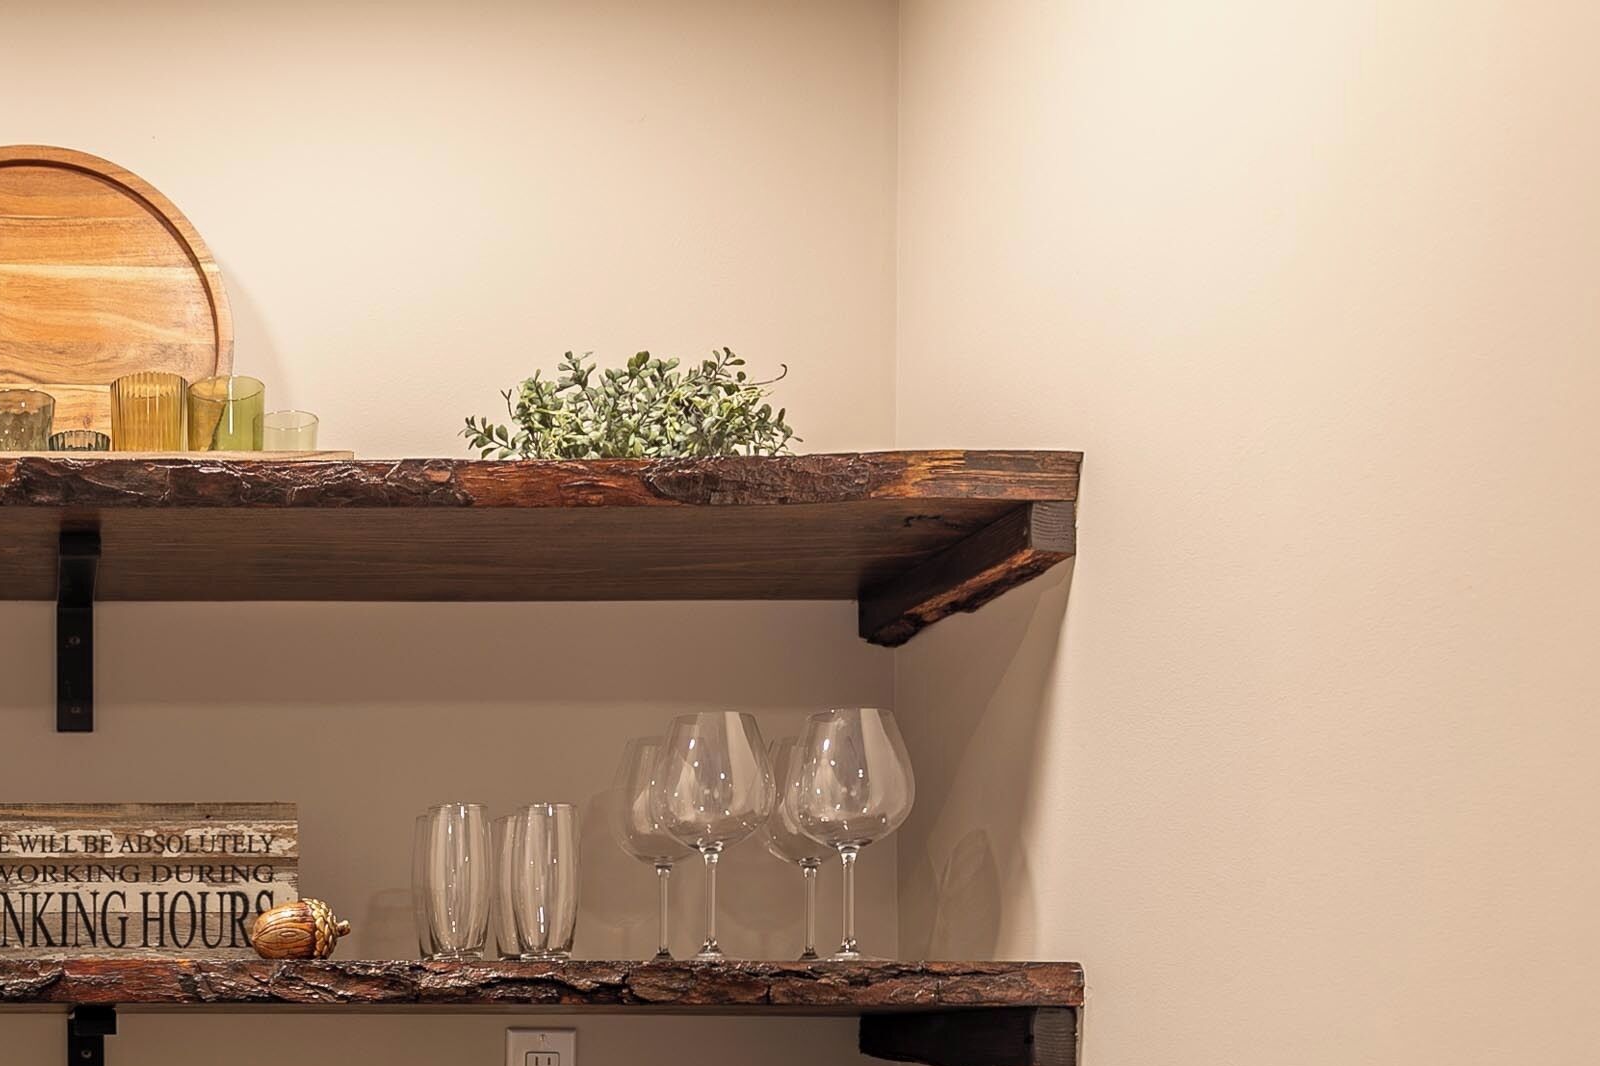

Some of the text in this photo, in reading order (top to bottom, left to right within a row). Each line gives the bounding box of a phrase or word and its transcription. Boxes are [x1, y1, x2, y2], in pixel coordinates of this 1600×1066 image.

[17, 834, 77, 854] WILL
[83, 834, 113, 853] BE
[119, 834, 275, 854] ABSOLUTELY
[151, 864, 274, 883] DURING
